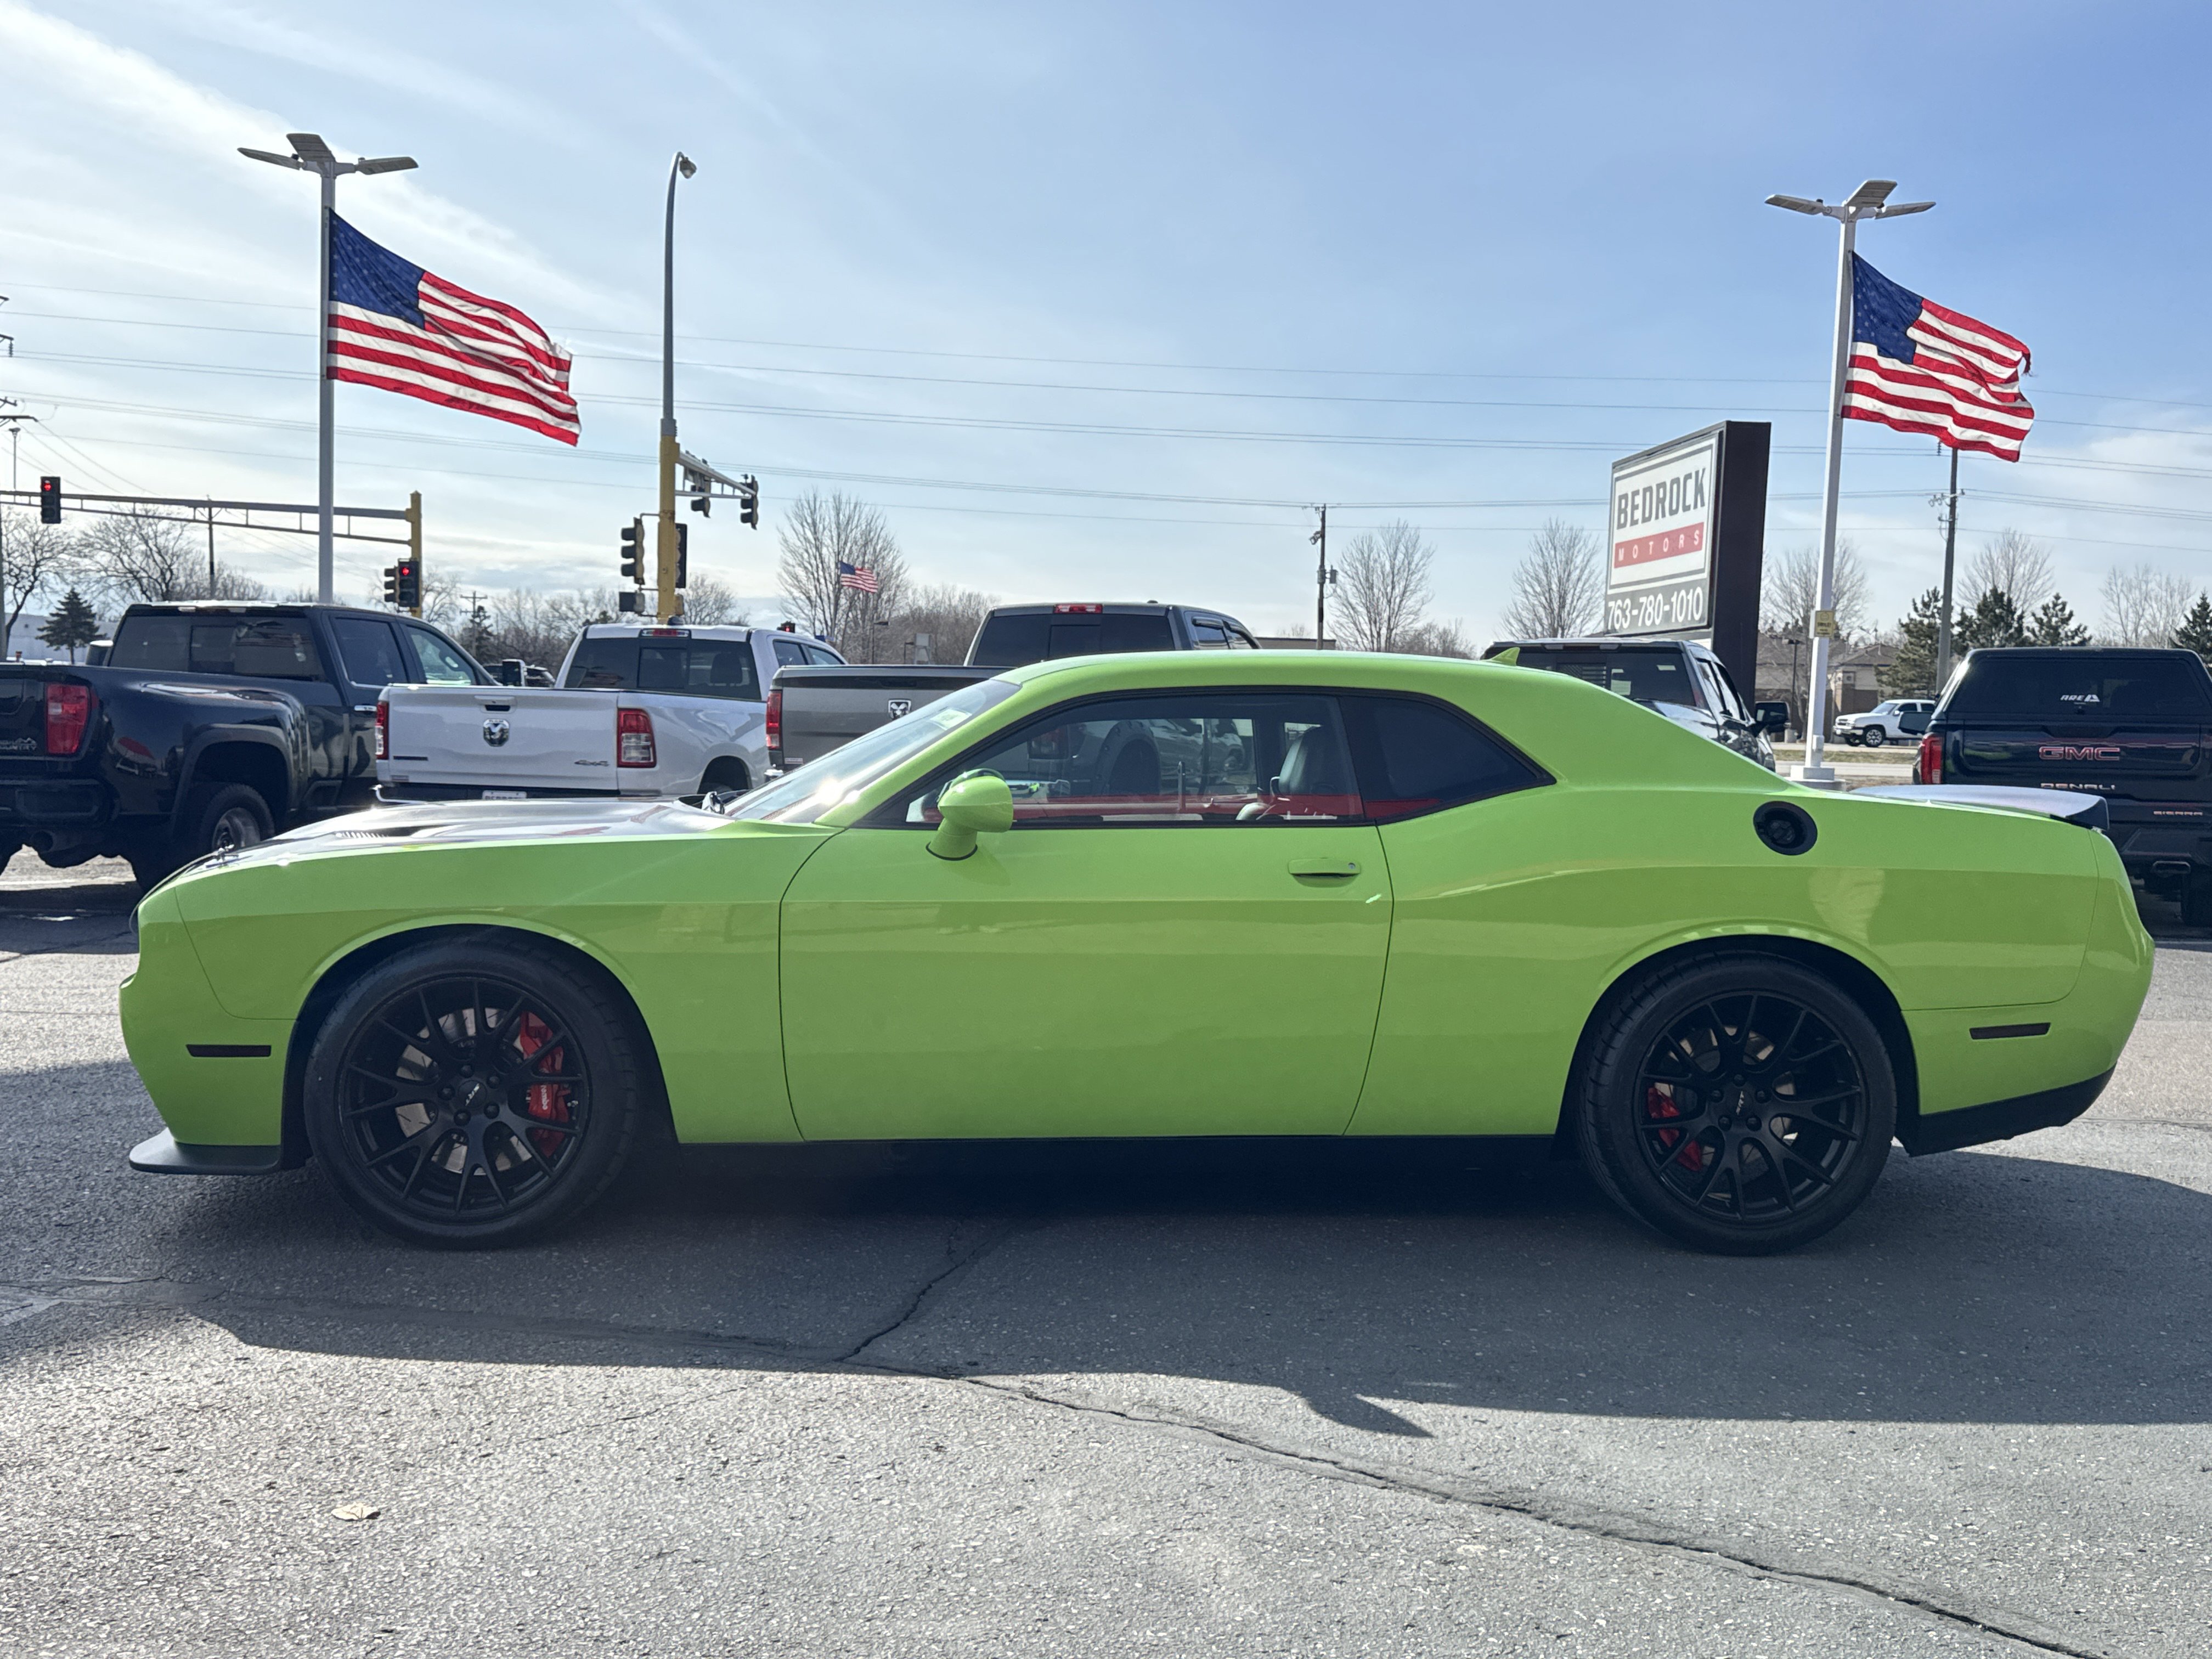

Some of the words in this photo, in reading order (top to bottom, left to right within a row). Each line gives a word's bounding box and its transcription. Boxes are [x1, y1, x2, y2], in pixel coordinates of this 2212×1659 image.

[1617, 467, 1706, 530] BEDROCK
[1618, 529, 1700, 561] MOTORS
[1607, 586, 1703, 630] 763-780-1010
[2039, 746, 2120, 761] GMC
[540, 1085, 549, 1110] rembo
